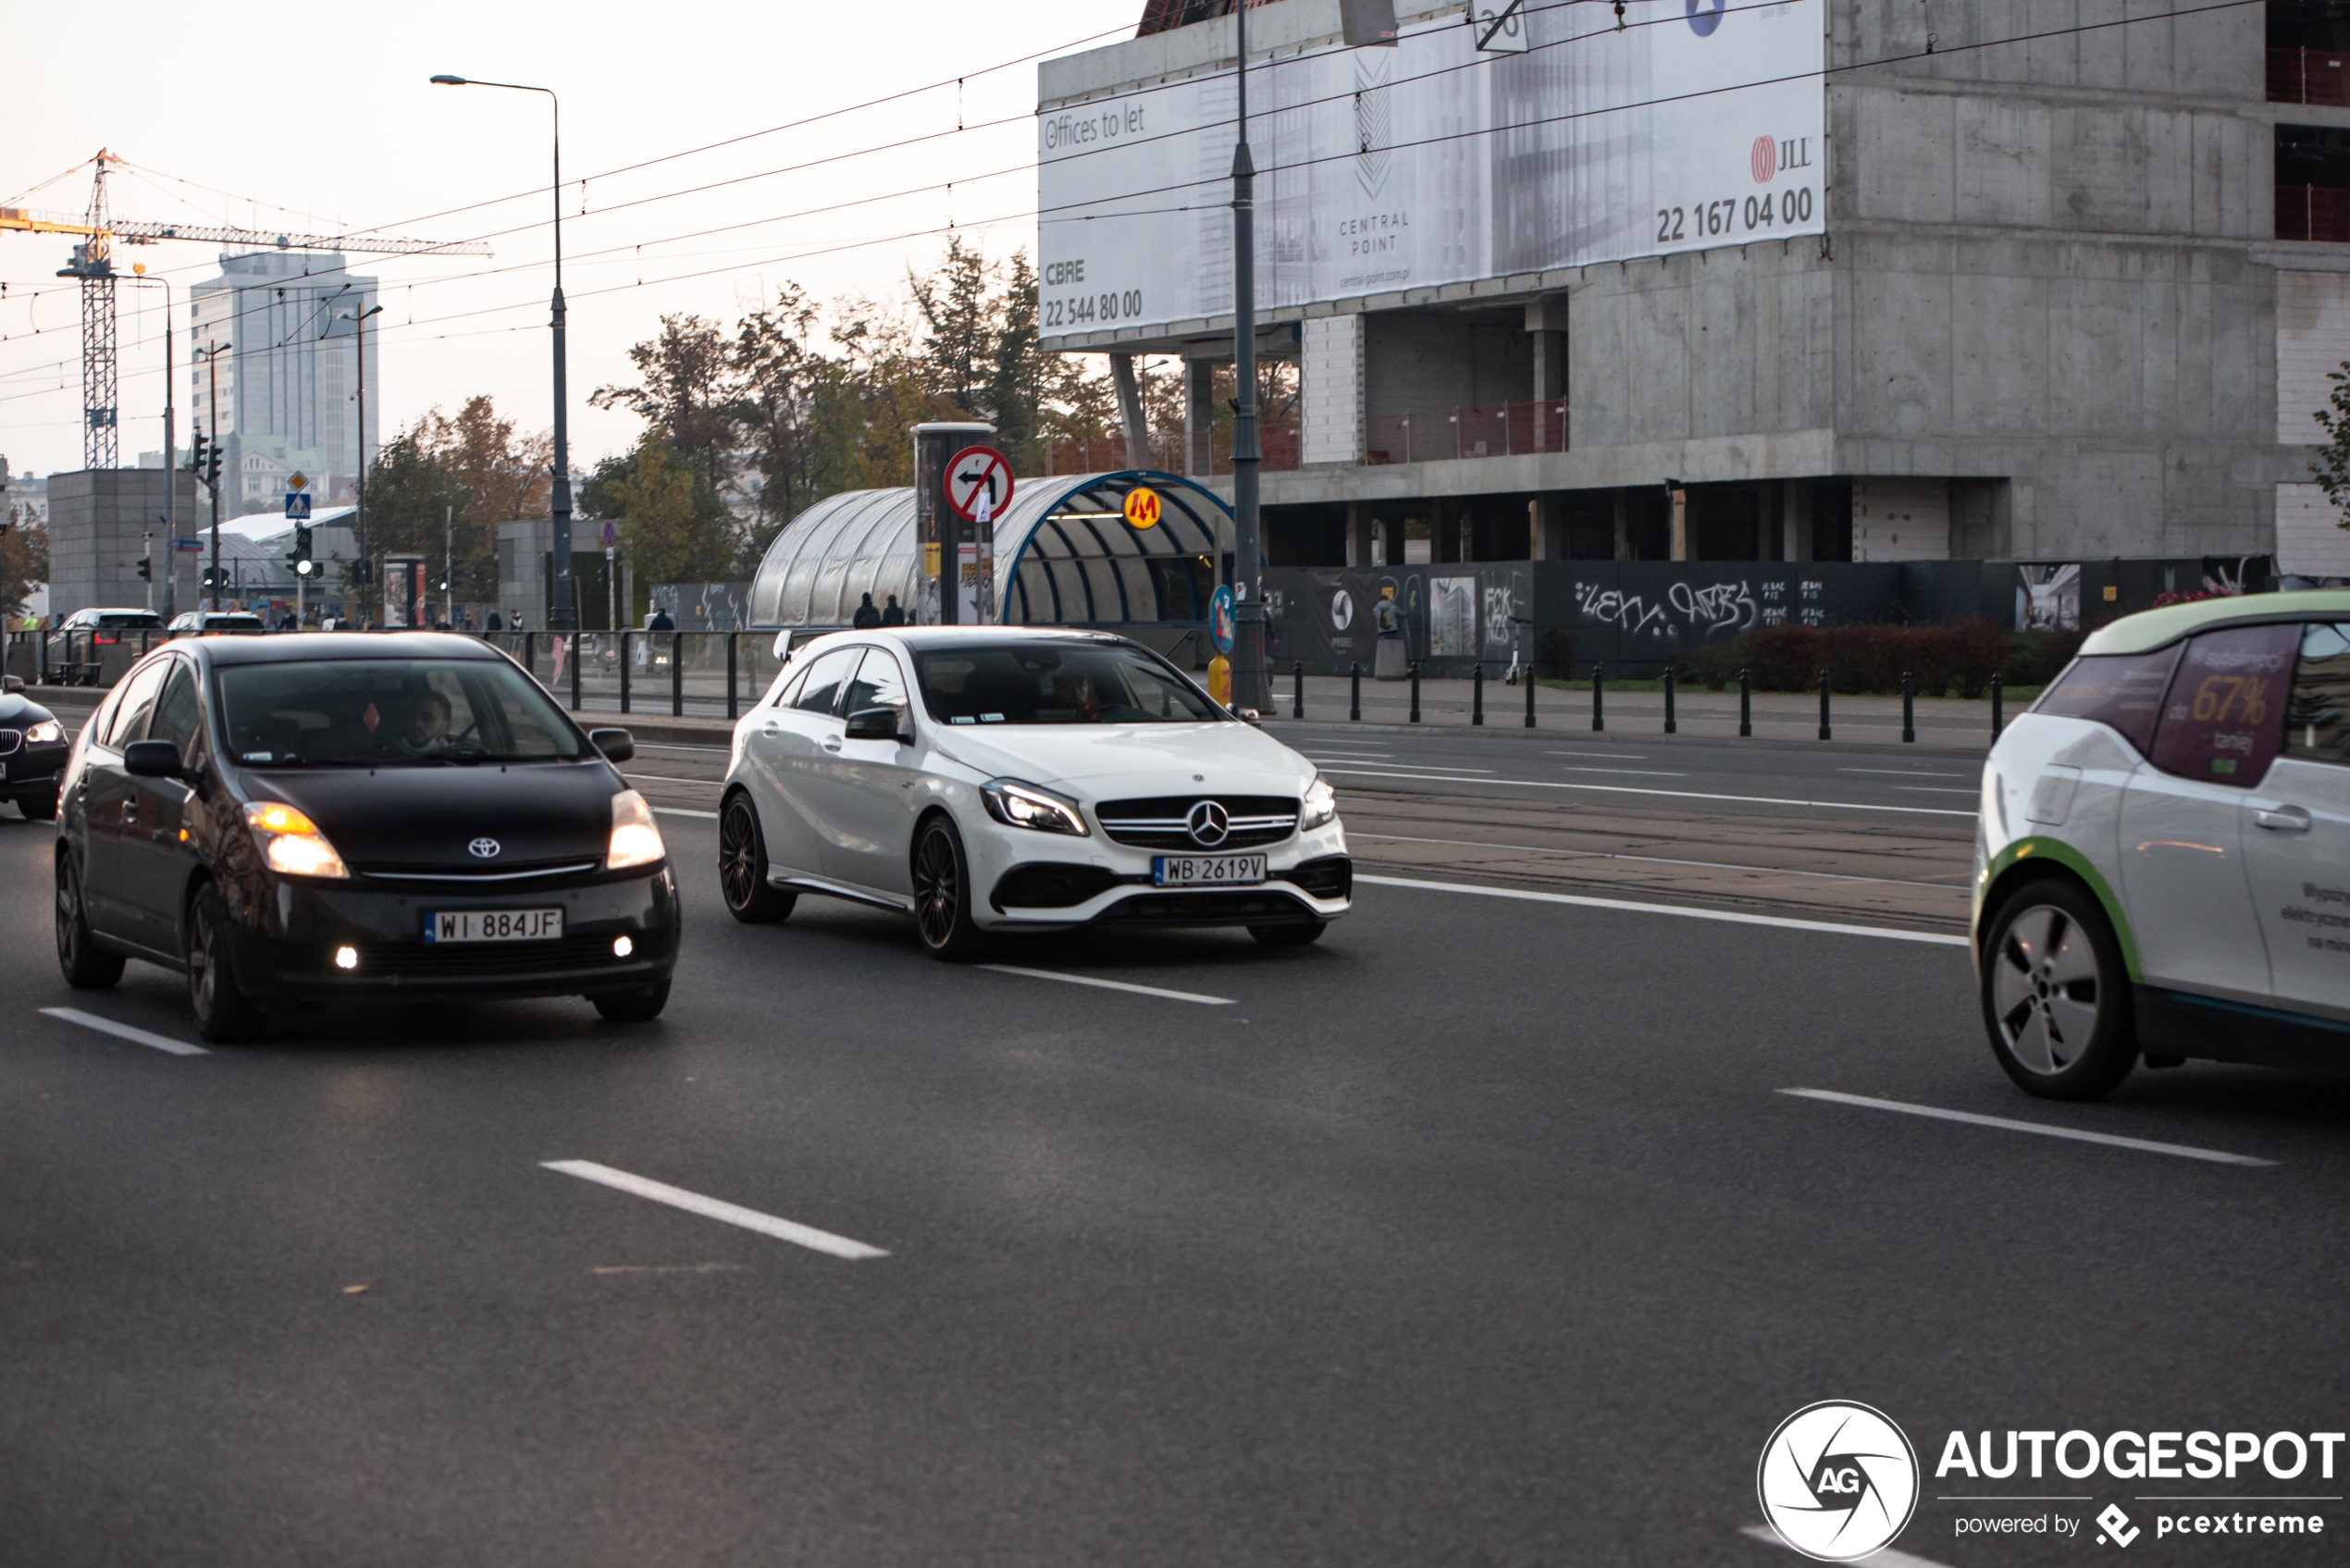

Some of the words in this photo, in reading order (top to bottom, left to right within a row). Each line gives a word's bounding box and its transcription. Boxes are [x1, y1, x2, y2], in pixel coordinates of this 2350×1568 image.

[1045, 114, 1098, 150] Offices
[1102, 111, 1119, 138] to
[1124, 103, 1144, 134] let
[1777, 137, 1812, 171] JLL
[1339, 211, 1409, 236] CENTRAL
[1657, 206, 1685, 242] 22
[1694, 198, 1736, 237] 167
[1745, 192, 1774, 230] 04
[1782, 187, 1812, 225] 00
[1352, 235, 1396, 256] POINT
[1045, 259, 1084, 286] CBRE
[1340, 265, 1411, 289] central-point.com.pl
[1045, 299, 1063, 327] 22
[1069, 295, 1095, 325] 544
[1100, 292, 1118, 321] 80
[1123, 289, 1142, 317] 00
[1129, 493, 1156, 522] M
[1484, 586, 1512, 616] FCK
[2193, 674, 2270, 725] 67%
[1168, 859, 1194, 880] WB
[1202, 858, 1261, 880] 2619V
[440, 914, 468, 939] WI
[483, 912, 557, 938] 884JF
